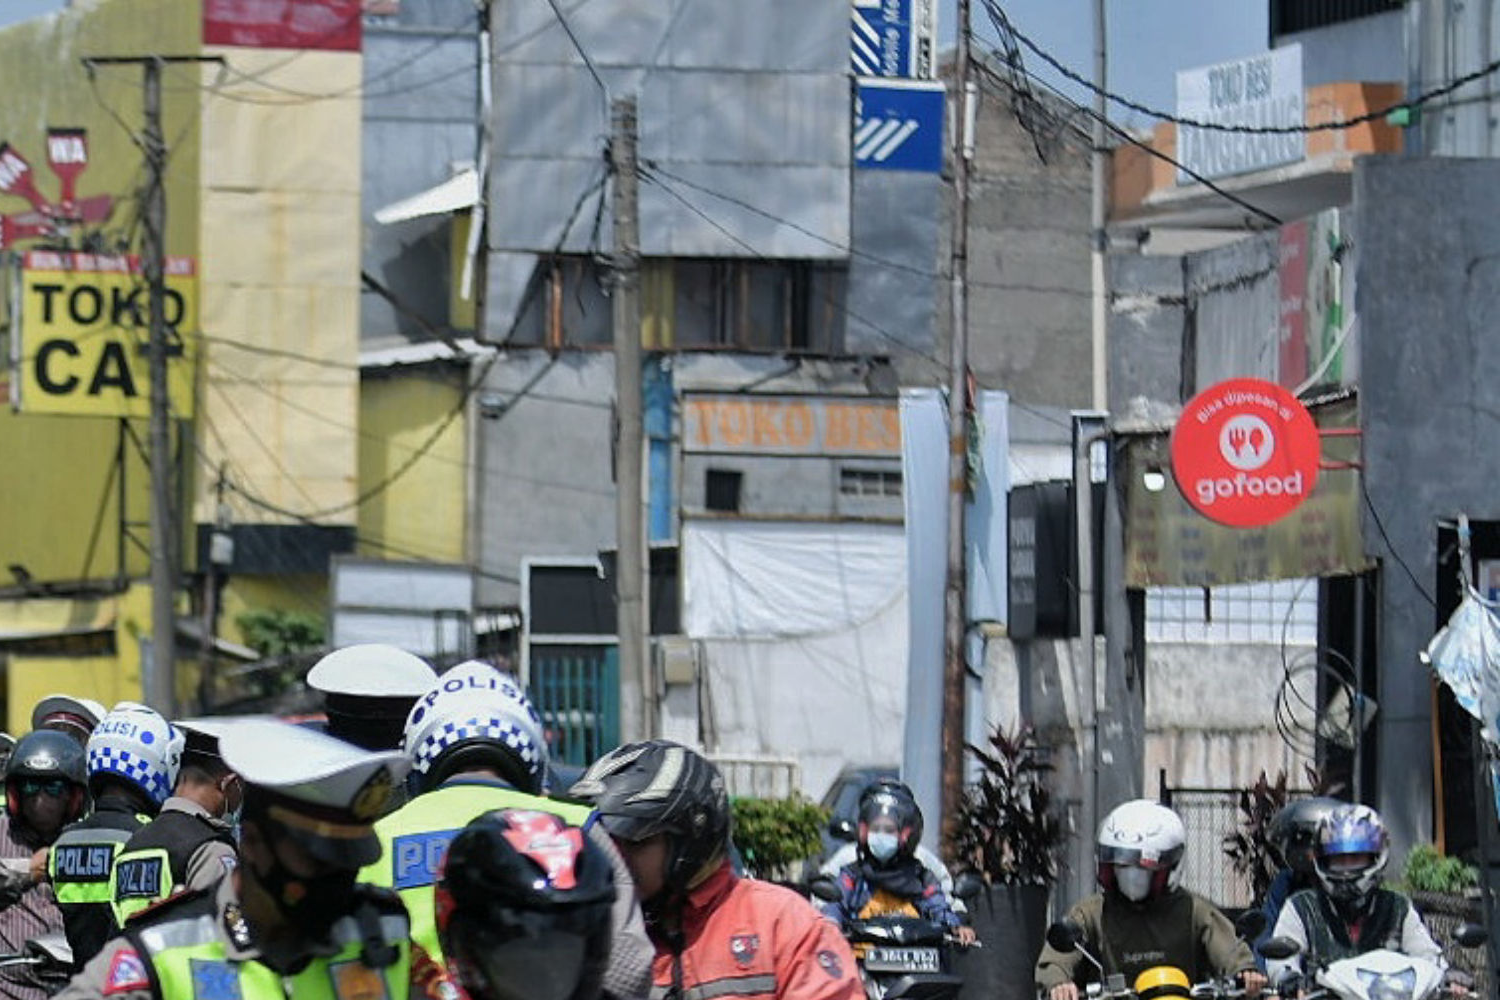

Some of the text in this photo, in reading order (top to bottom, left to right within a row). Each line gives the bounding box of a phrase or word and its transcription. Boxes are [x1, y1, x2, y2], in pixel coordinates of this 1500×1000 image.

[1223, 388, 1279, 412] dipesan
[692, 397, 815, 446] TOKO
[1196, 470, 1303, 506] gofood
[426, 674, 525, 706] POLISI
[56, 847, 111, 876] POLISI
